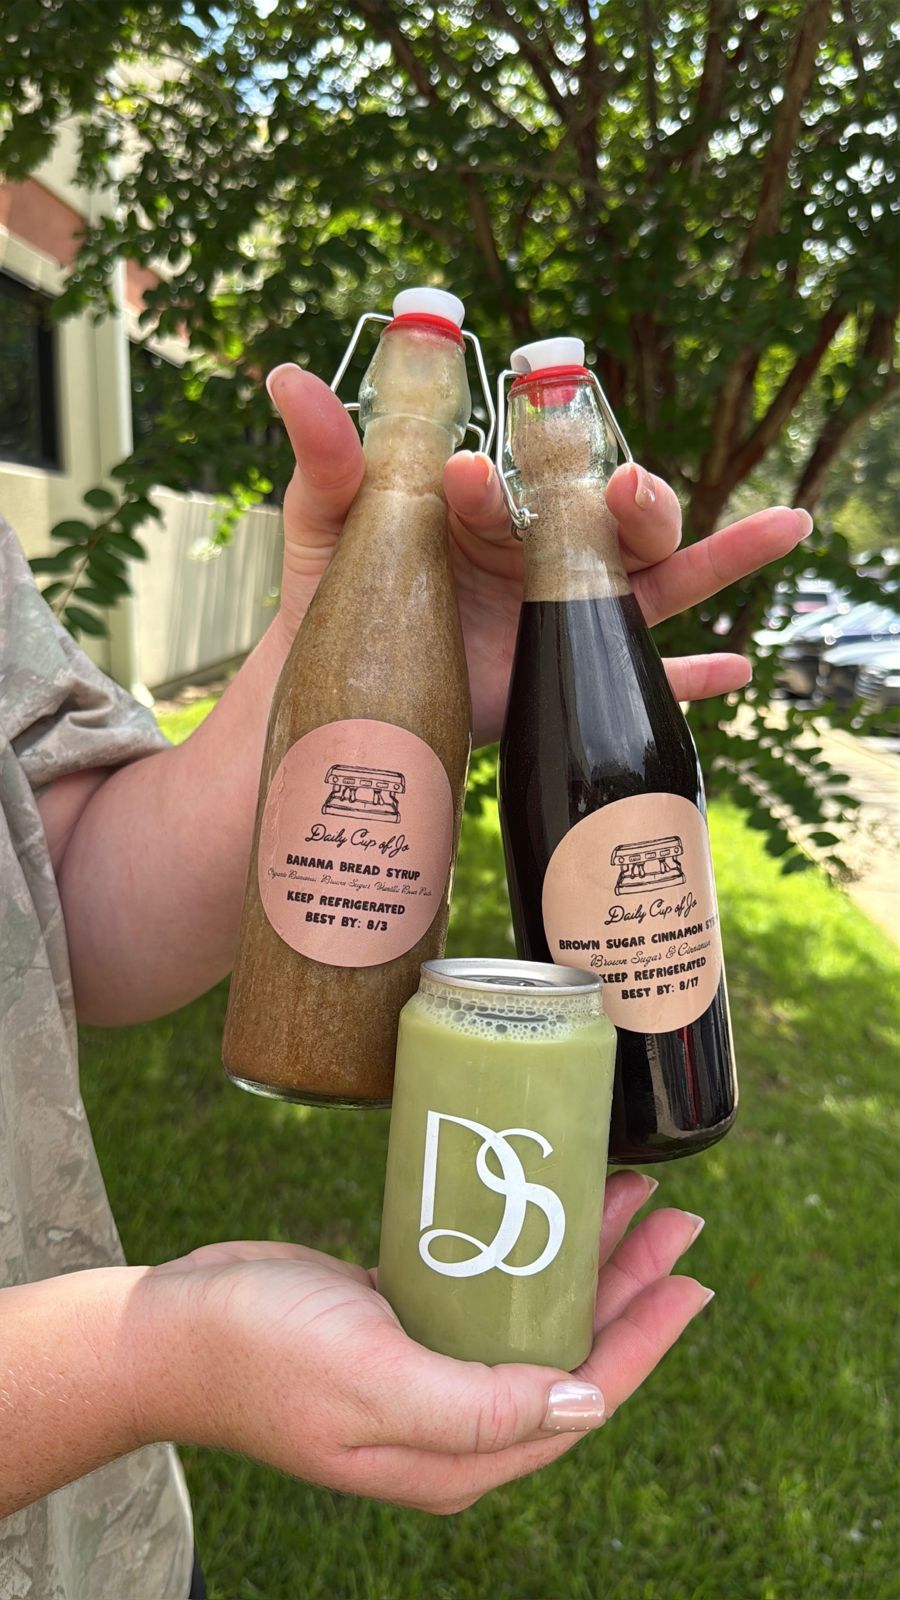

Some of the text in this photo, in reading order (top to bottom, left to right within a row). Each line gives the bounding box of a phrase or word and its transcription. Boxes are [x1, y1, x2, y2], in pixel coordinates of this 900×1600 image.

[304, 823, 410, 858] Daily Cup of Jo
[286, 854, 420, 881] BANANA BREAD SYRUP
[287, 890, 406, 915] KEEP REFRIGERATED
[604, 891, 698, 925] Daily Cup of Jo
[305, 911, 388, 932] BEST BY: 8/3
[558, 939, 600, 950] BROWN
[606, 936, 646, 950] SUGAR
[651, 923, 704, 944] CINNAMON
[590, 953, 627, 968] Brown
[630, 951, 662, 968] Sugar
[665, 945, 677, 959] &
[598, 957, 707, 984] KEEP REFRIGERATED
[621, 976, 699, 1000] BEST BY: 8/17
